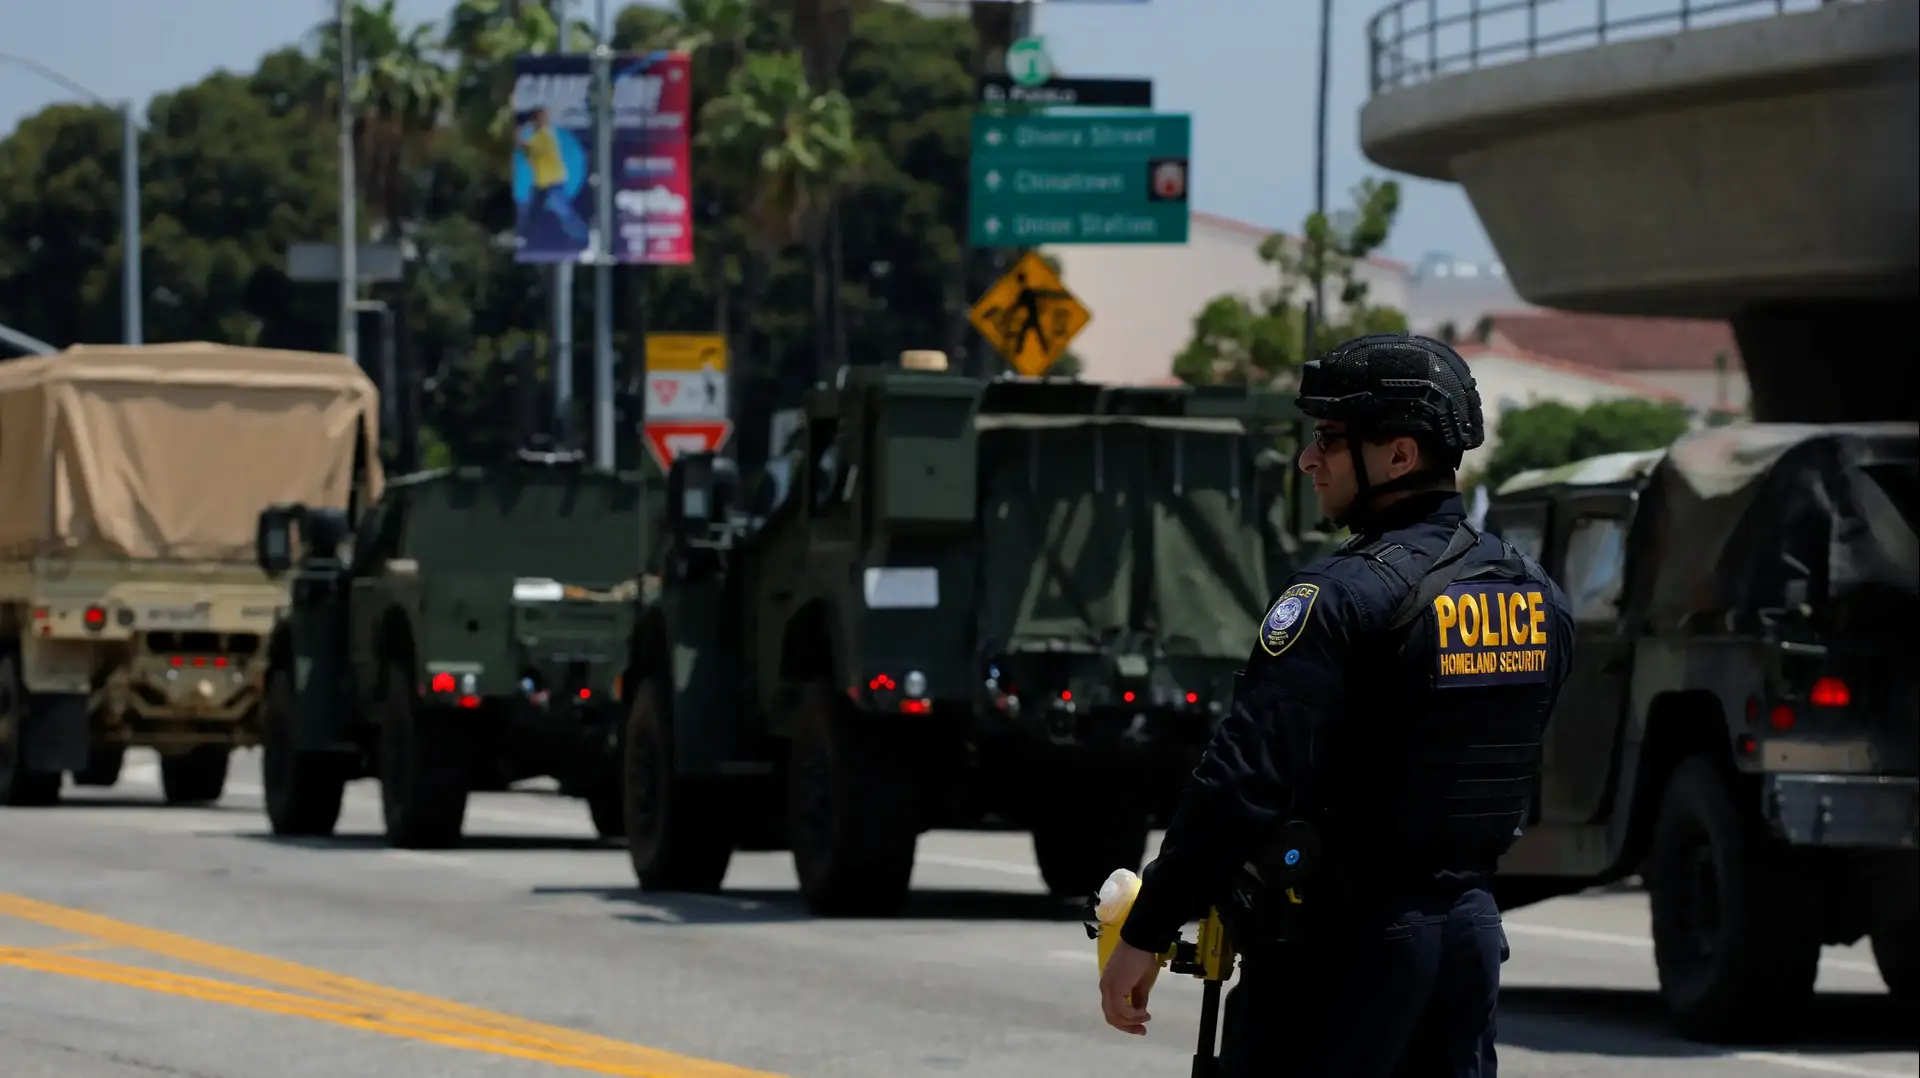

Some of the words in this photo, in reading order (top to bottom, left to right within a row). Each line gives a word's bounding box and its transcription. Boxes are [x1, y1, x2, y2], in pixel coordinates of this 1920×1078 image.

[1090, 126, 1154, 146] Street
[1015, 170, 1123, 191] Chinatown
[1014, 215, 1073, 236] Union
[1080, 214, 1157, 236] Station
[1434, 592, 1547, 648] POLICE
[1440, 652, 1497, 676] HOMELAND
[1500, 650, 1546, 673] SECURITY
